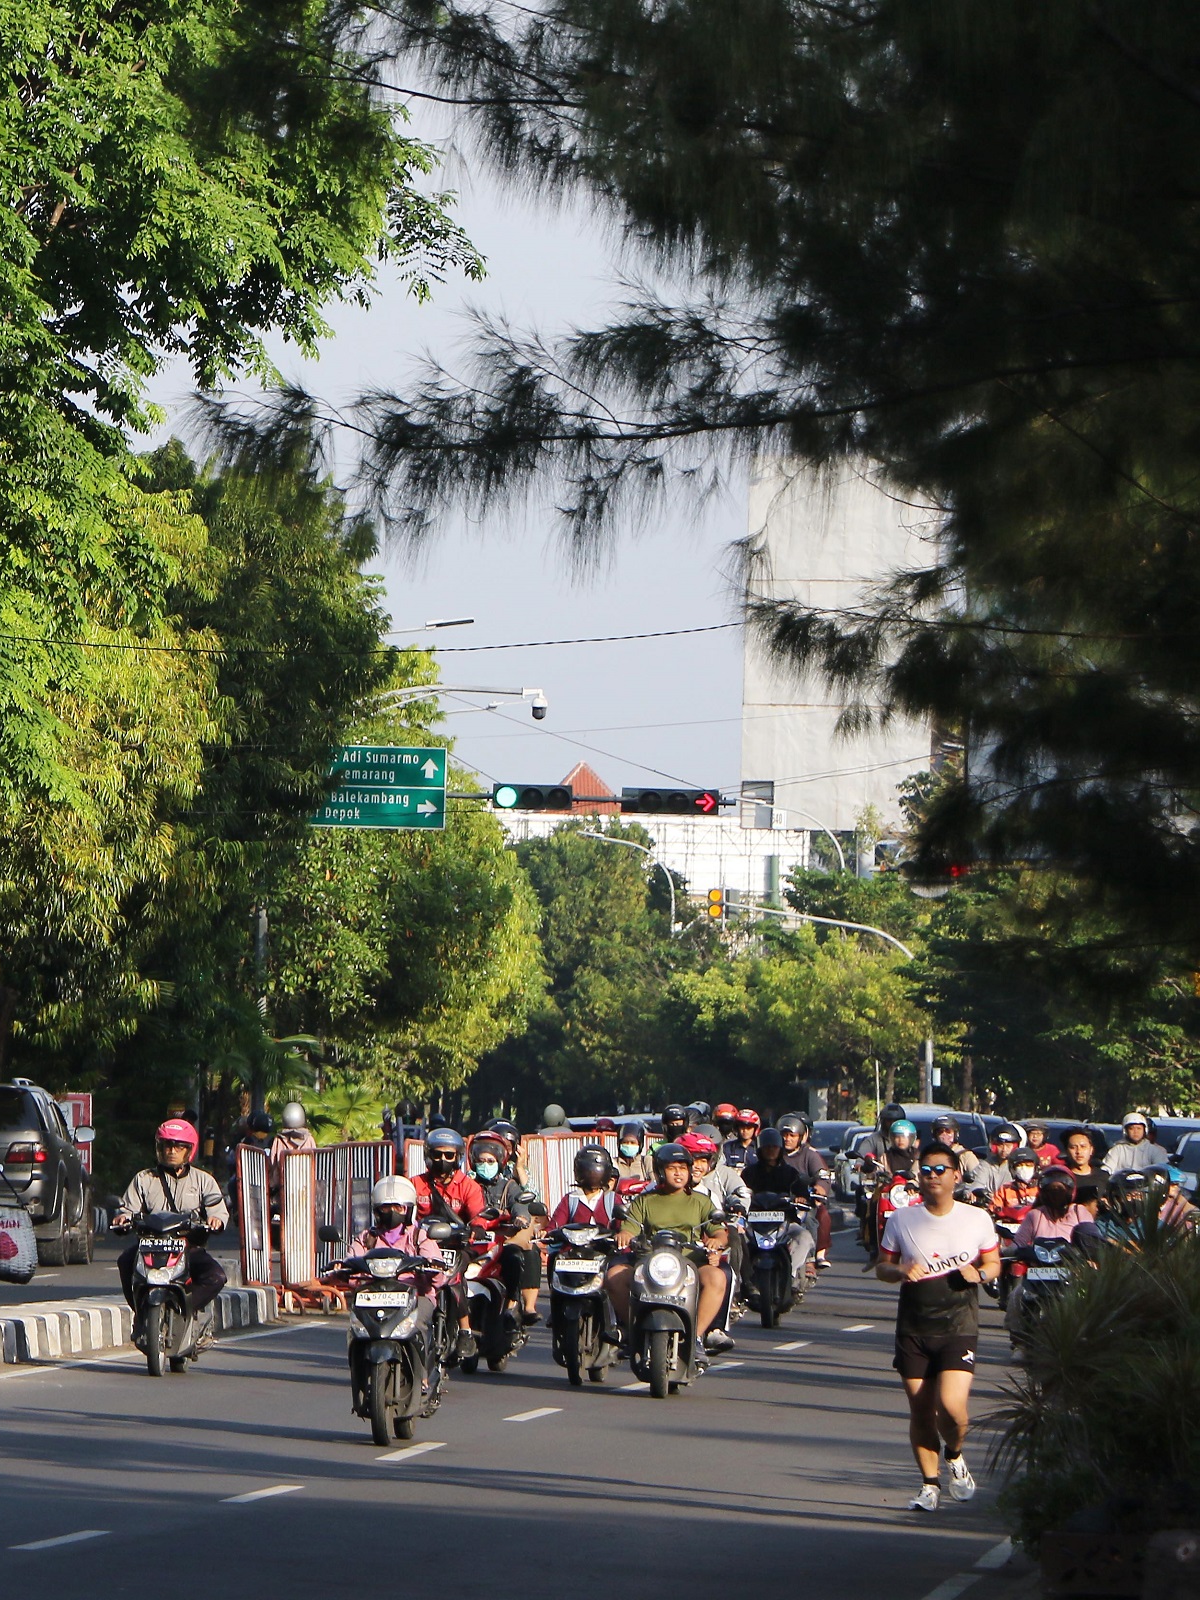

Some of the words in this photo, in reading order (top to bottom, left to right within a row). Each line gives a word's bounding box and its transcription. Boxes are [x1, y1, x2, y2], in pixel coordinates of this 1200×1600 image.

[342, 751, 362, 764] Adi
[366, 751, 420, 765] Sumarmo
[340, 768, 396, 782] emarang
[331, 791, 410, 808] Balekambang
[325, 807, 361, 821] Depok
